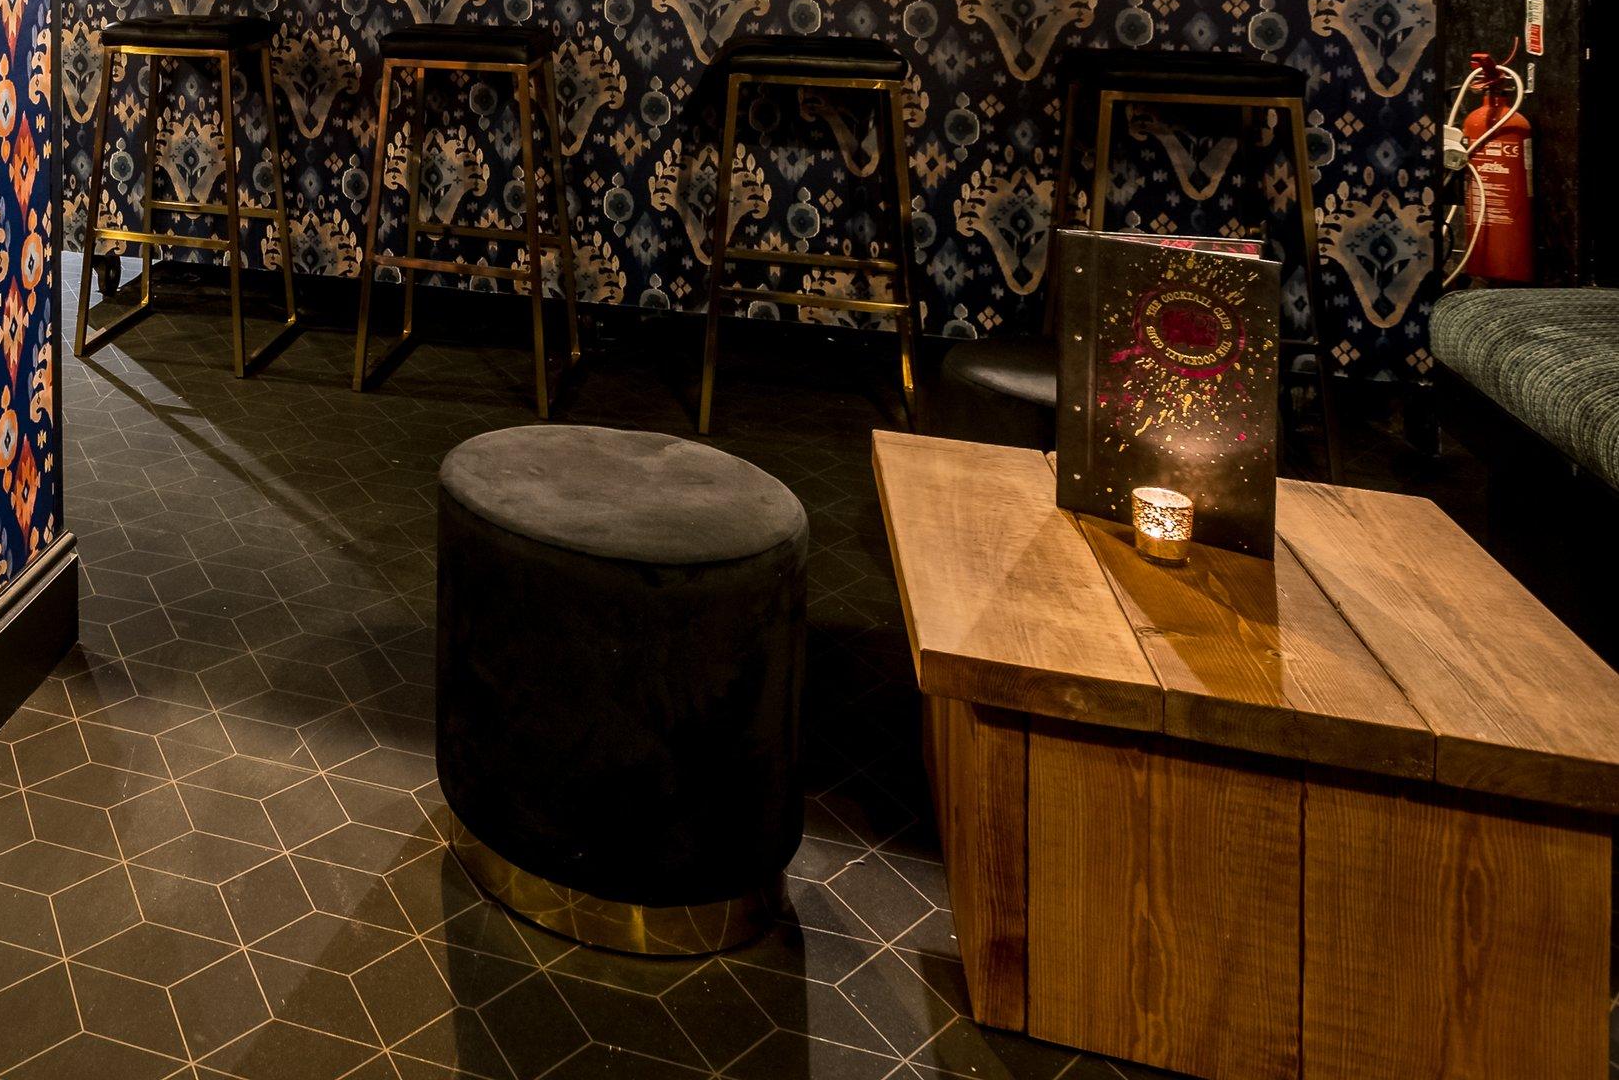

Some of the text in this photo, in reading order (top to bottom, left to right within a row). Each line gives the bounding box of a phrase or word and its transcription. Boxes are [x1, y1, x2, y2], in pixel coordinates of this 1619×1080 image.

[1145, 291, 1232, 330] THE COCKTAIL CLUB
[1146, 325, 1232, 366] THE COCKTAIL CLUB
